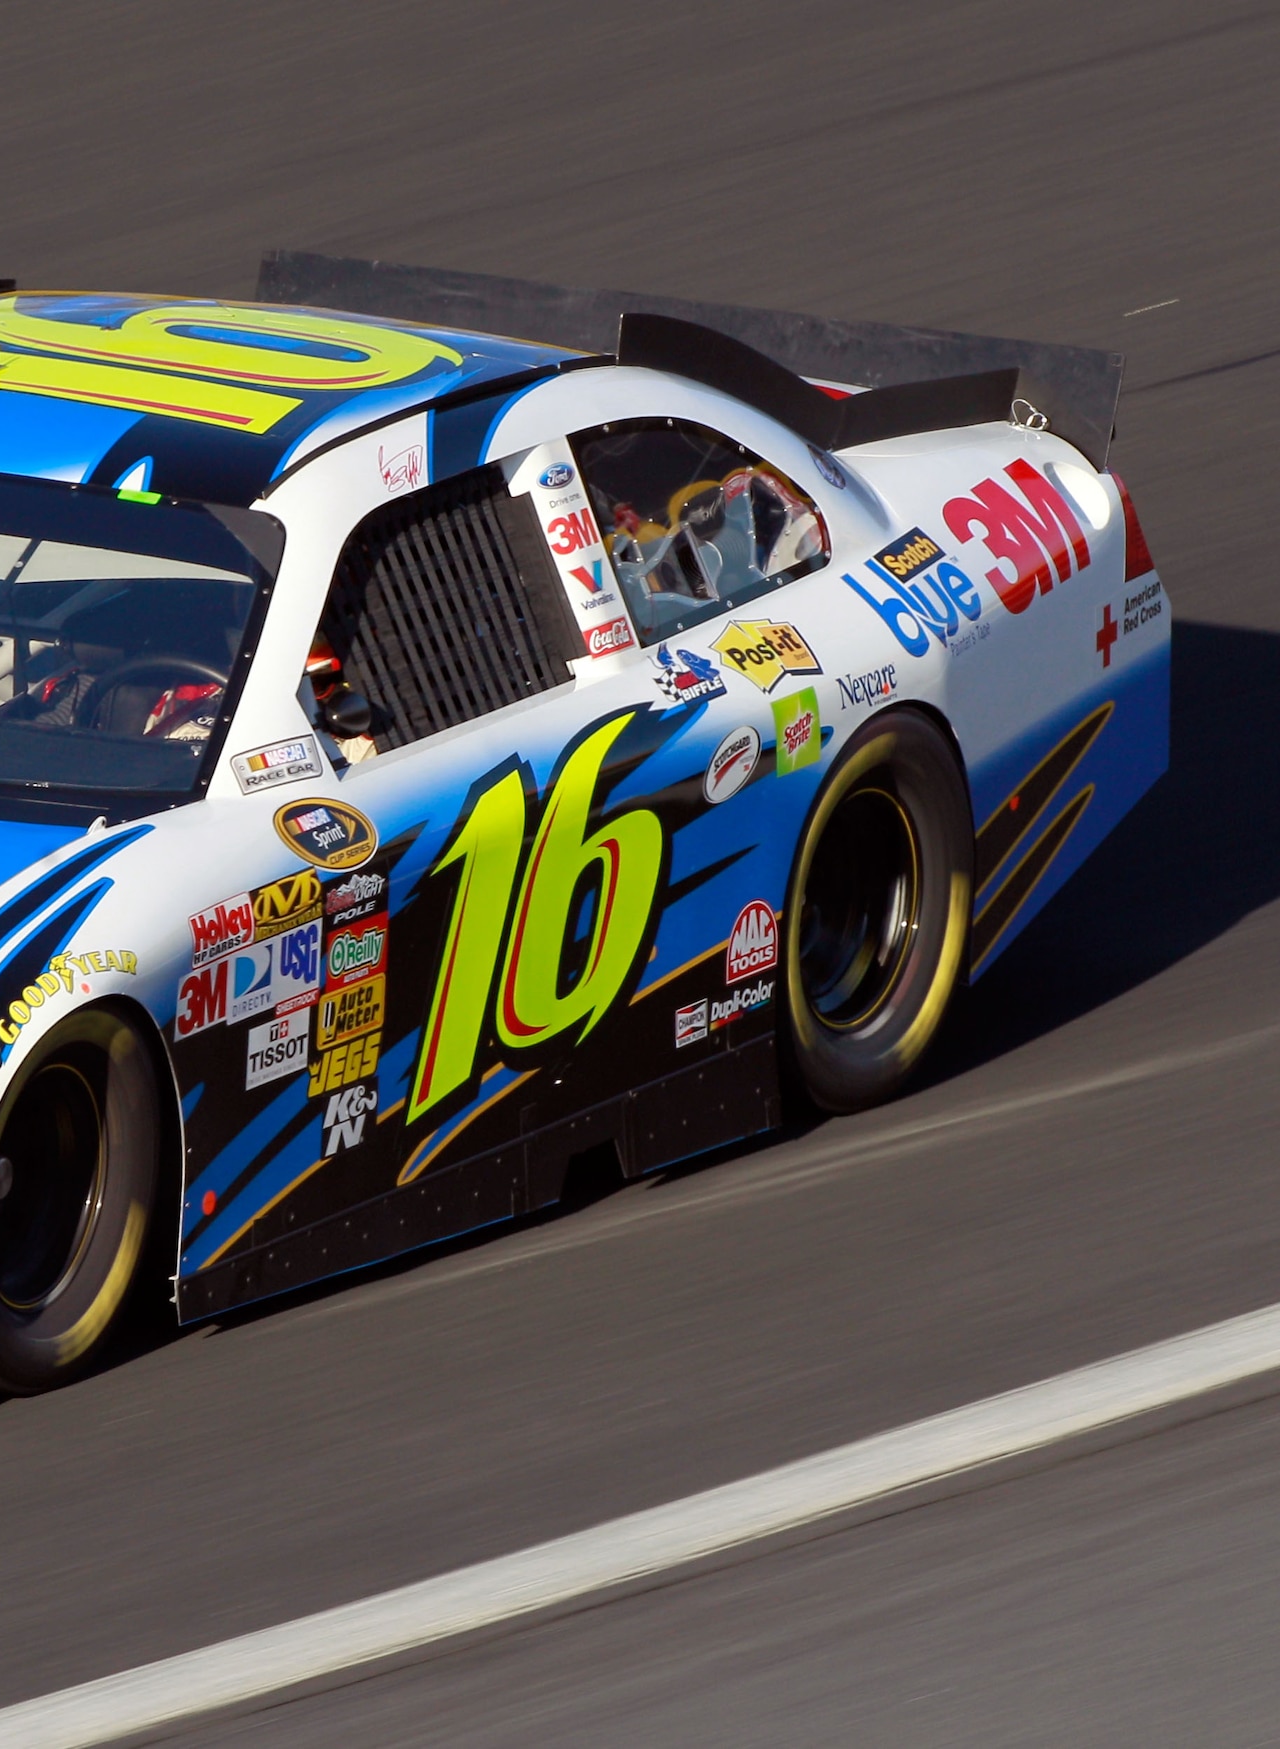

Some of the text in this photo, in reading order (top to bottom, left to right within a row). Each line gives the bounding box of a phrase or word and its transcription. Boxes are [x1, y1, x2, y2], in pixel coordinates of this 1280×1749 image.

[547, 467, 570, 486] Ford
[547, 508, 599, 555] 3M
[943, 458, 1091, 615] 3M
[883, 534, 939, 577] Scotch
[841, 556, 981, 658] blue
[1124, 582, 1161, 615] American
[1123, 601, 1162, 635] Red Cross
[726, 627, 803, 670] Post-it
[681, 675, 723, 701] BIFFLE
[836, 663, 896, 710] Nexcare
[265, 743, 306, 767] NASCAR
[787, 727, 811, 755] Brite
[297, 808, 331, 832] NASCAR
[313, 823, 346, 849] Sprint
[330, 844, 371, 865] CUP SERIES
[355, 878, 386, 902] LIGHT
[190, 903, 253, 953] Holley
[333, 900, 376, 925] POLE
[405, 711, 663, 1126] 16
[194, 936, 242, 964] HP CARBS
[730, 908, 775, 961] MAC
[280, 925, 318, 984] USG
[331, 933, 383, 975] O'Reilly
[730, 946, 775, 974] TOOLS
[178, 960, 229, 1035] 3M
[232, 991, 272, 1017] DIRECTV
[338, 985, 374, 1014] Auto
[711, 980, 776, 1020] Dupli-Color
[336, 1003, 381, 1034] Meter
[249, 1033, 308, 1074] TISSOT
[308, 1031, 382, 1098] JEGS
